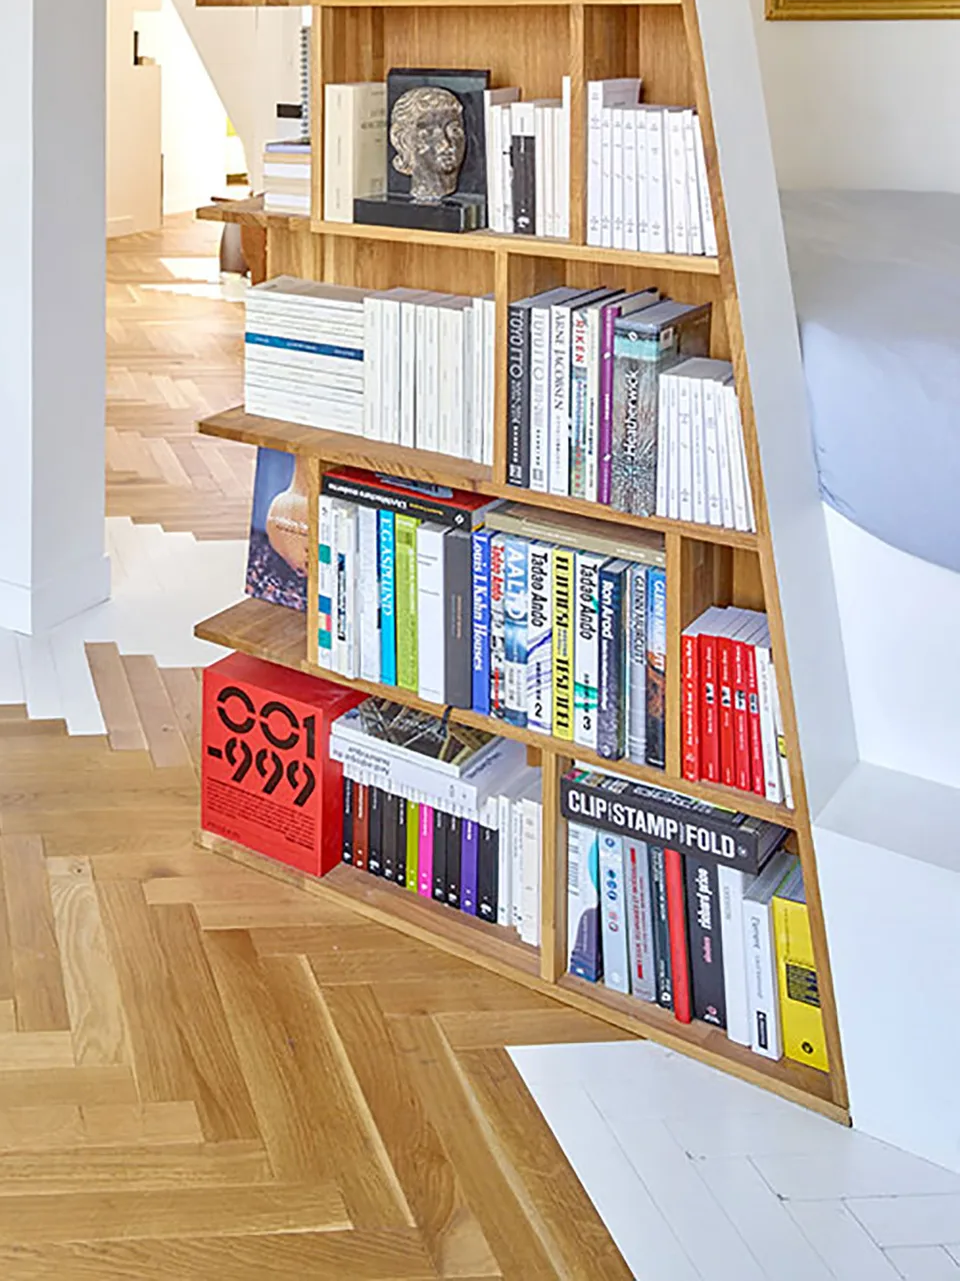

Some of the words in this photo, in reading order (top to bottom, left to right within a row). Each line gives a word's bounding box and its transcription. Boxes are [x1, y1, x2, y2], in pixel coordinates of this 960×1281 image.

[509, 309, 524, 346] TOYO
[553, 310, 567, 347] ARNE
[574, 319, 585, 363] RIKEN
[509, 347, 524, 379] ITO
[553, 349, 567, 412] JACOBSEN
[623, 368, 639, 459] Heatherwick
[475, 534, 488, 571] Louis
[492, 545, 505, 574] Tadao
[381, 552, 393, 616] ASPLUND
[491, 575, 504, 601] Ando
[531, 552, 548, 593] Tadao
[579, 563, 598, 605] Tadao
[473, 586, 486, 620] Kahn
[531, 593, 547, 628] Ando
[600, 581, 614, 605] Ron
[634, 576, 645, 613] GLENN
[579, 605, 595, 641] Ando
[634, 615, 645, 666] MURCUTT
[473, 621, 484, 670] Houses
[534, 704, 544, 718] 2
[582, 716, 592, 731] 3
[568, 789, 608, 821] CLIP
[612, 801, 678, 842] STAMP
[686, 825, 736, 859] FOLD
